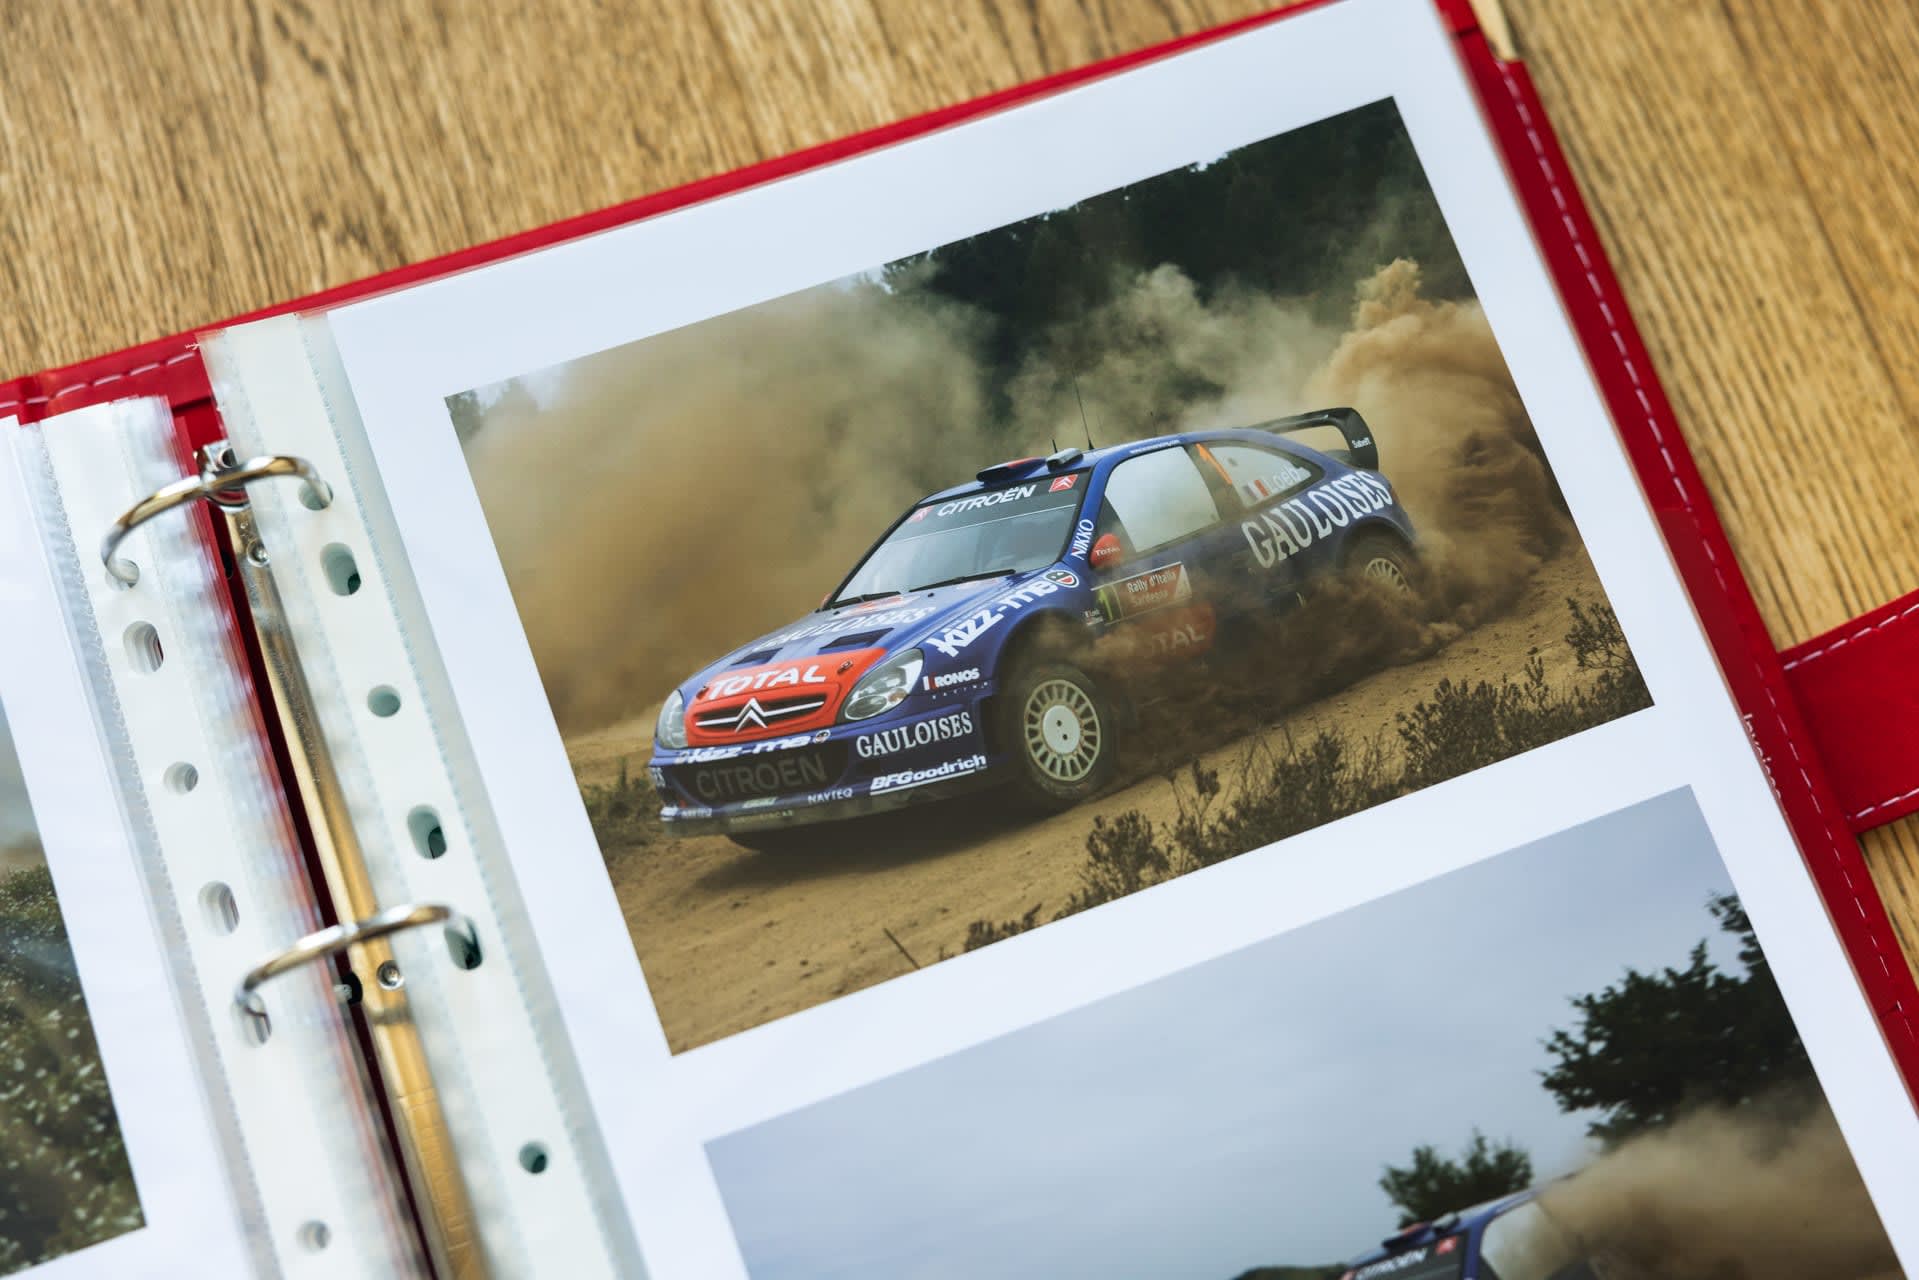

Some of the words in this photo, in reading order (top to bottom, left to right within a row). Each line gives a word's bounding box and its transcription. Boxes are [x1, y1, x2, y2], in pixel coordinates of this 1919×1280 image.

[935, 485, 1037, 518] CITROËN
[1242, 470, 1393, 568] GAULOISES
[1071, 519, 1095, 560] NIKKO
[1127, 580, 1149, 594] Rally
[708, 665, 828, 701] TOTAL
[855, 711, 974, 759] GAULOISES
[695, 750, 828, 800] CITROËN
[869, 754, 987, 792] BFGoodrich
